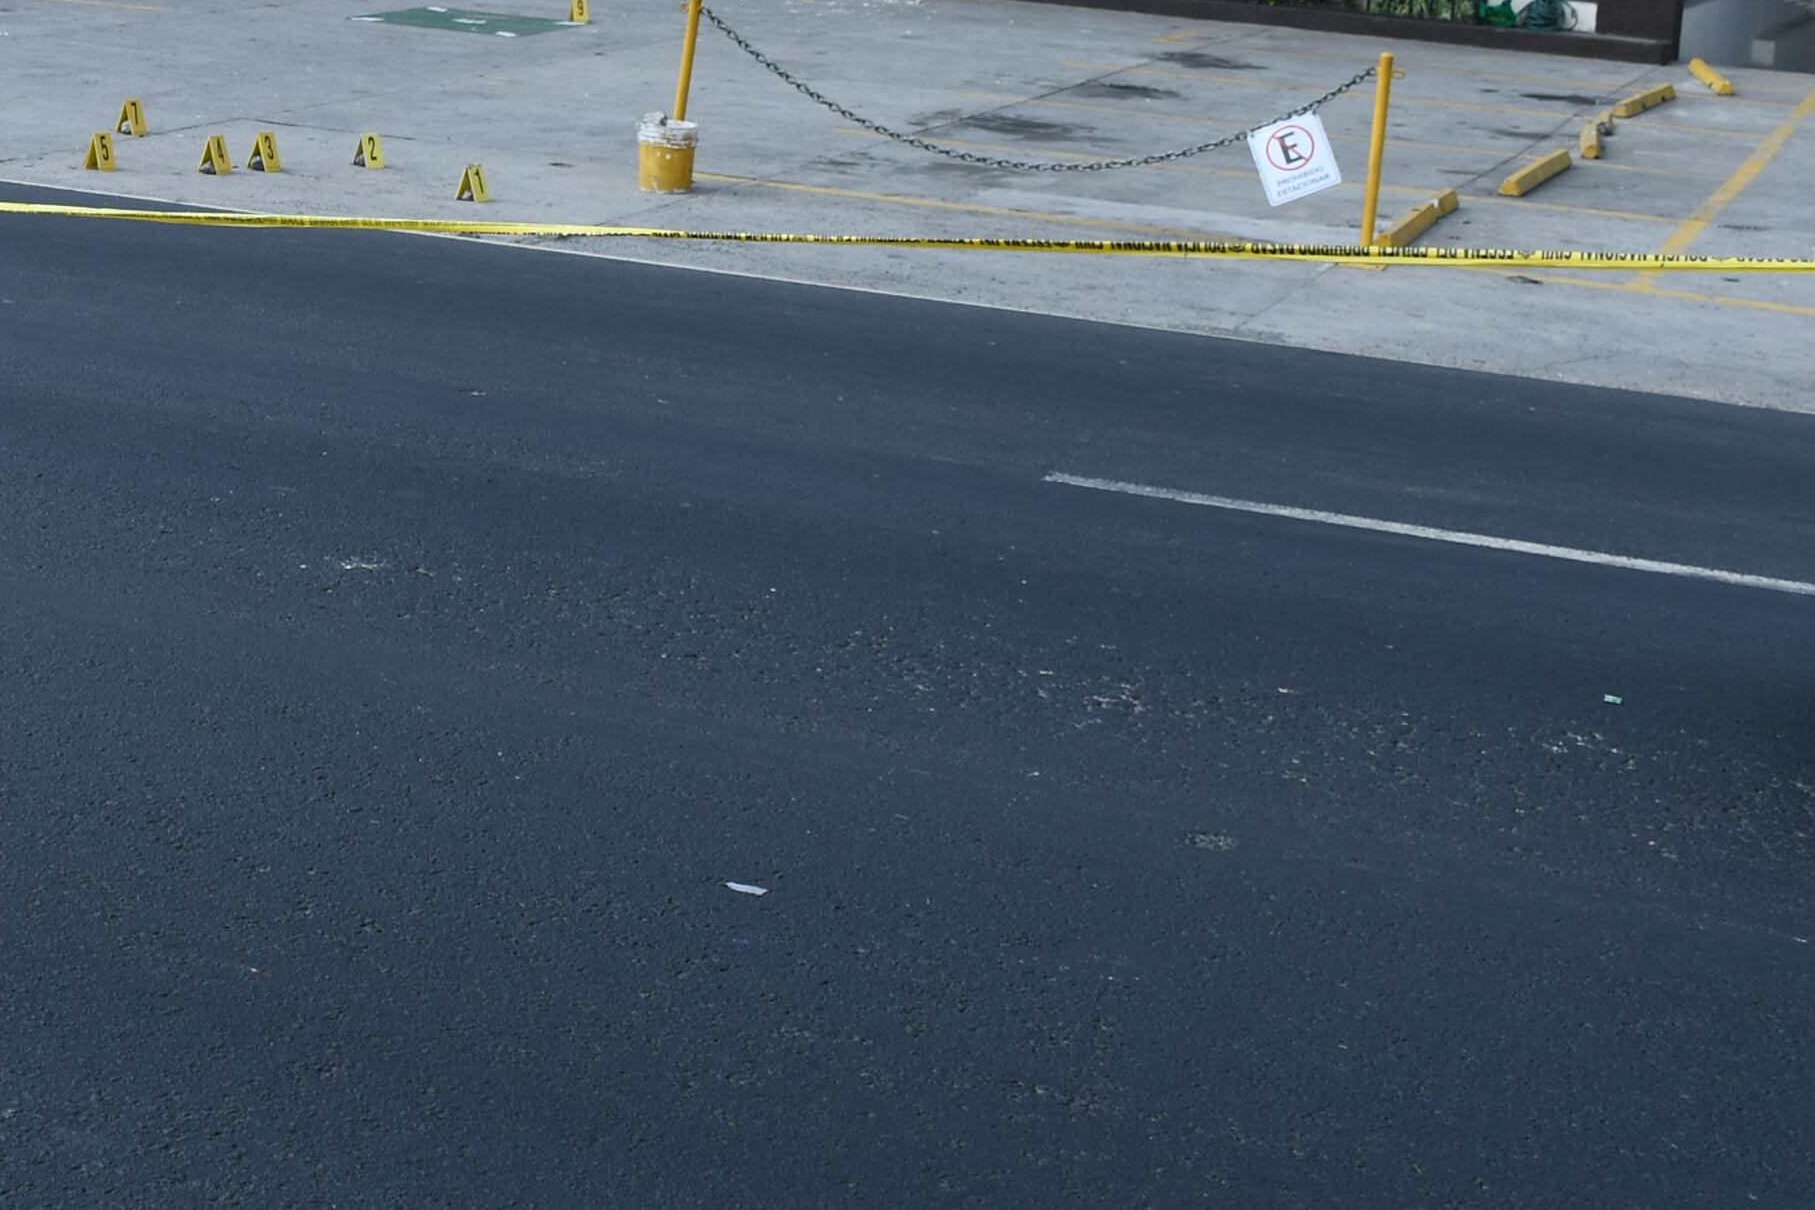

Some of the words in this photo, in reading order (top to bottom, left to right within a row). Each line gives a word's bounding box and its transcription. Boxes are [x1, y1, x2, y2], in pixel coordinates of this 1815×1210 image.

[130, 101, 140, 126] 7
[99, 135, 110, 161] 5
[216, 136, 225, 163] 4
[264, 135, 275, 160] 3
[367, 136, 378, 161] 2
[1277, 131, 1304, 165] E
